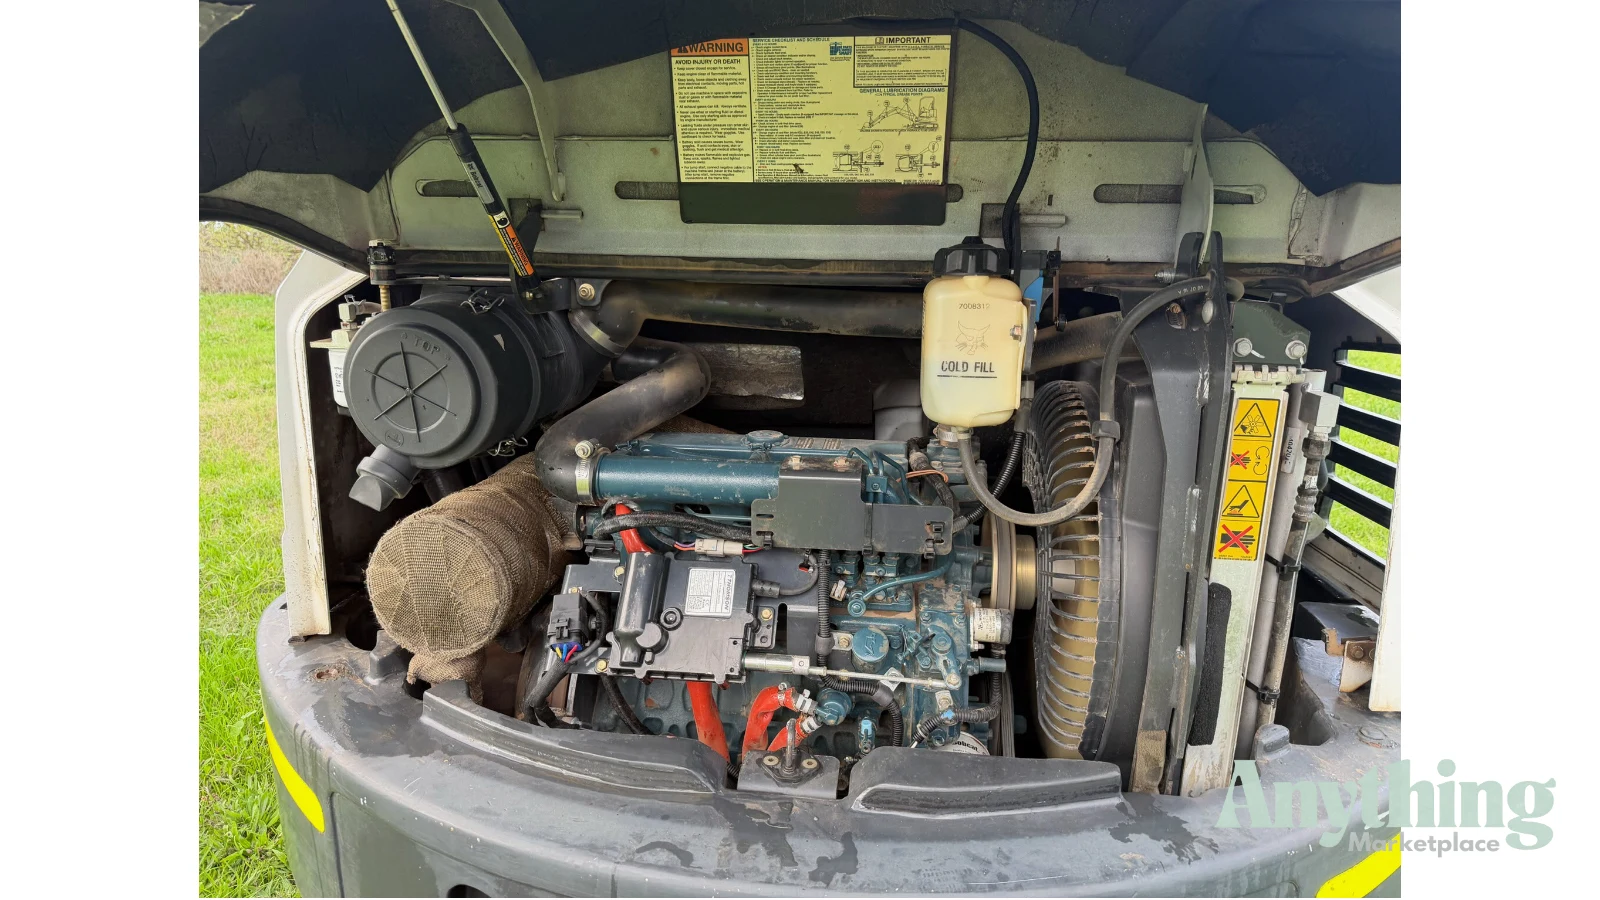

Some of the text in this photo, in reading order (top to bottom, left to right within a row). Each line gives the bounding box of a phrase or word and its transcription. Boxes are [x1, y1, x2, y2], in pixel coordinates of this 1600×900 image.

[689, 42, 743, 52] WARNING
[470, 171, 483, 188] Bobcat
[515, 240, 529, 266] WARNING
[414, 334, 440, 354] TOP
[941, 360, 995, 373] COLD FILL
[723, 578, 732, 611] THOMSON
